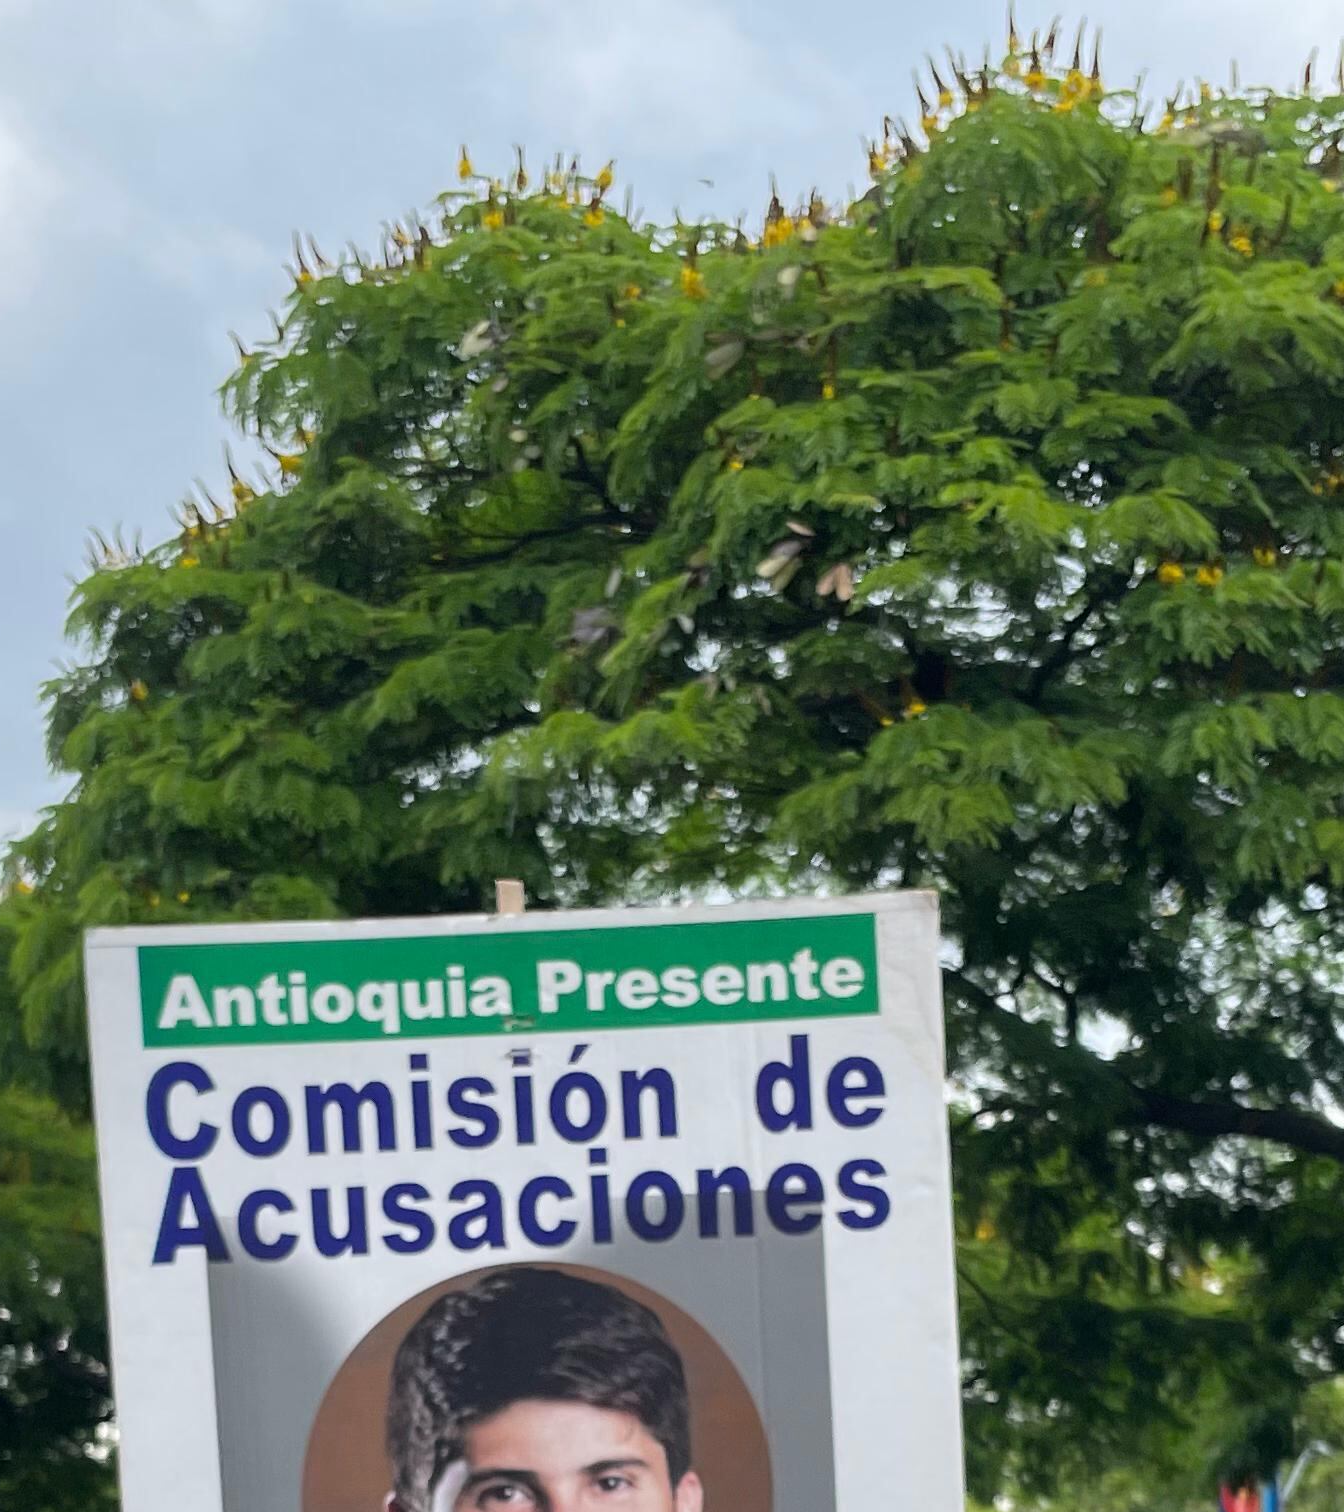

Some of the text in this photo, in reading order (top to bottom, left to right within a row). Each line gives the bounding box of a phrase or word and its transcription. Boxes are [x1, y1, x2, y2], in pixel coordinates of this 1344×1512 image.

[157, 948, 866, 1034] Antioquia Presente
[145, 1034, 887, 1161] Comisión de
[151, 1149, 892, 1265] Acusaciones
